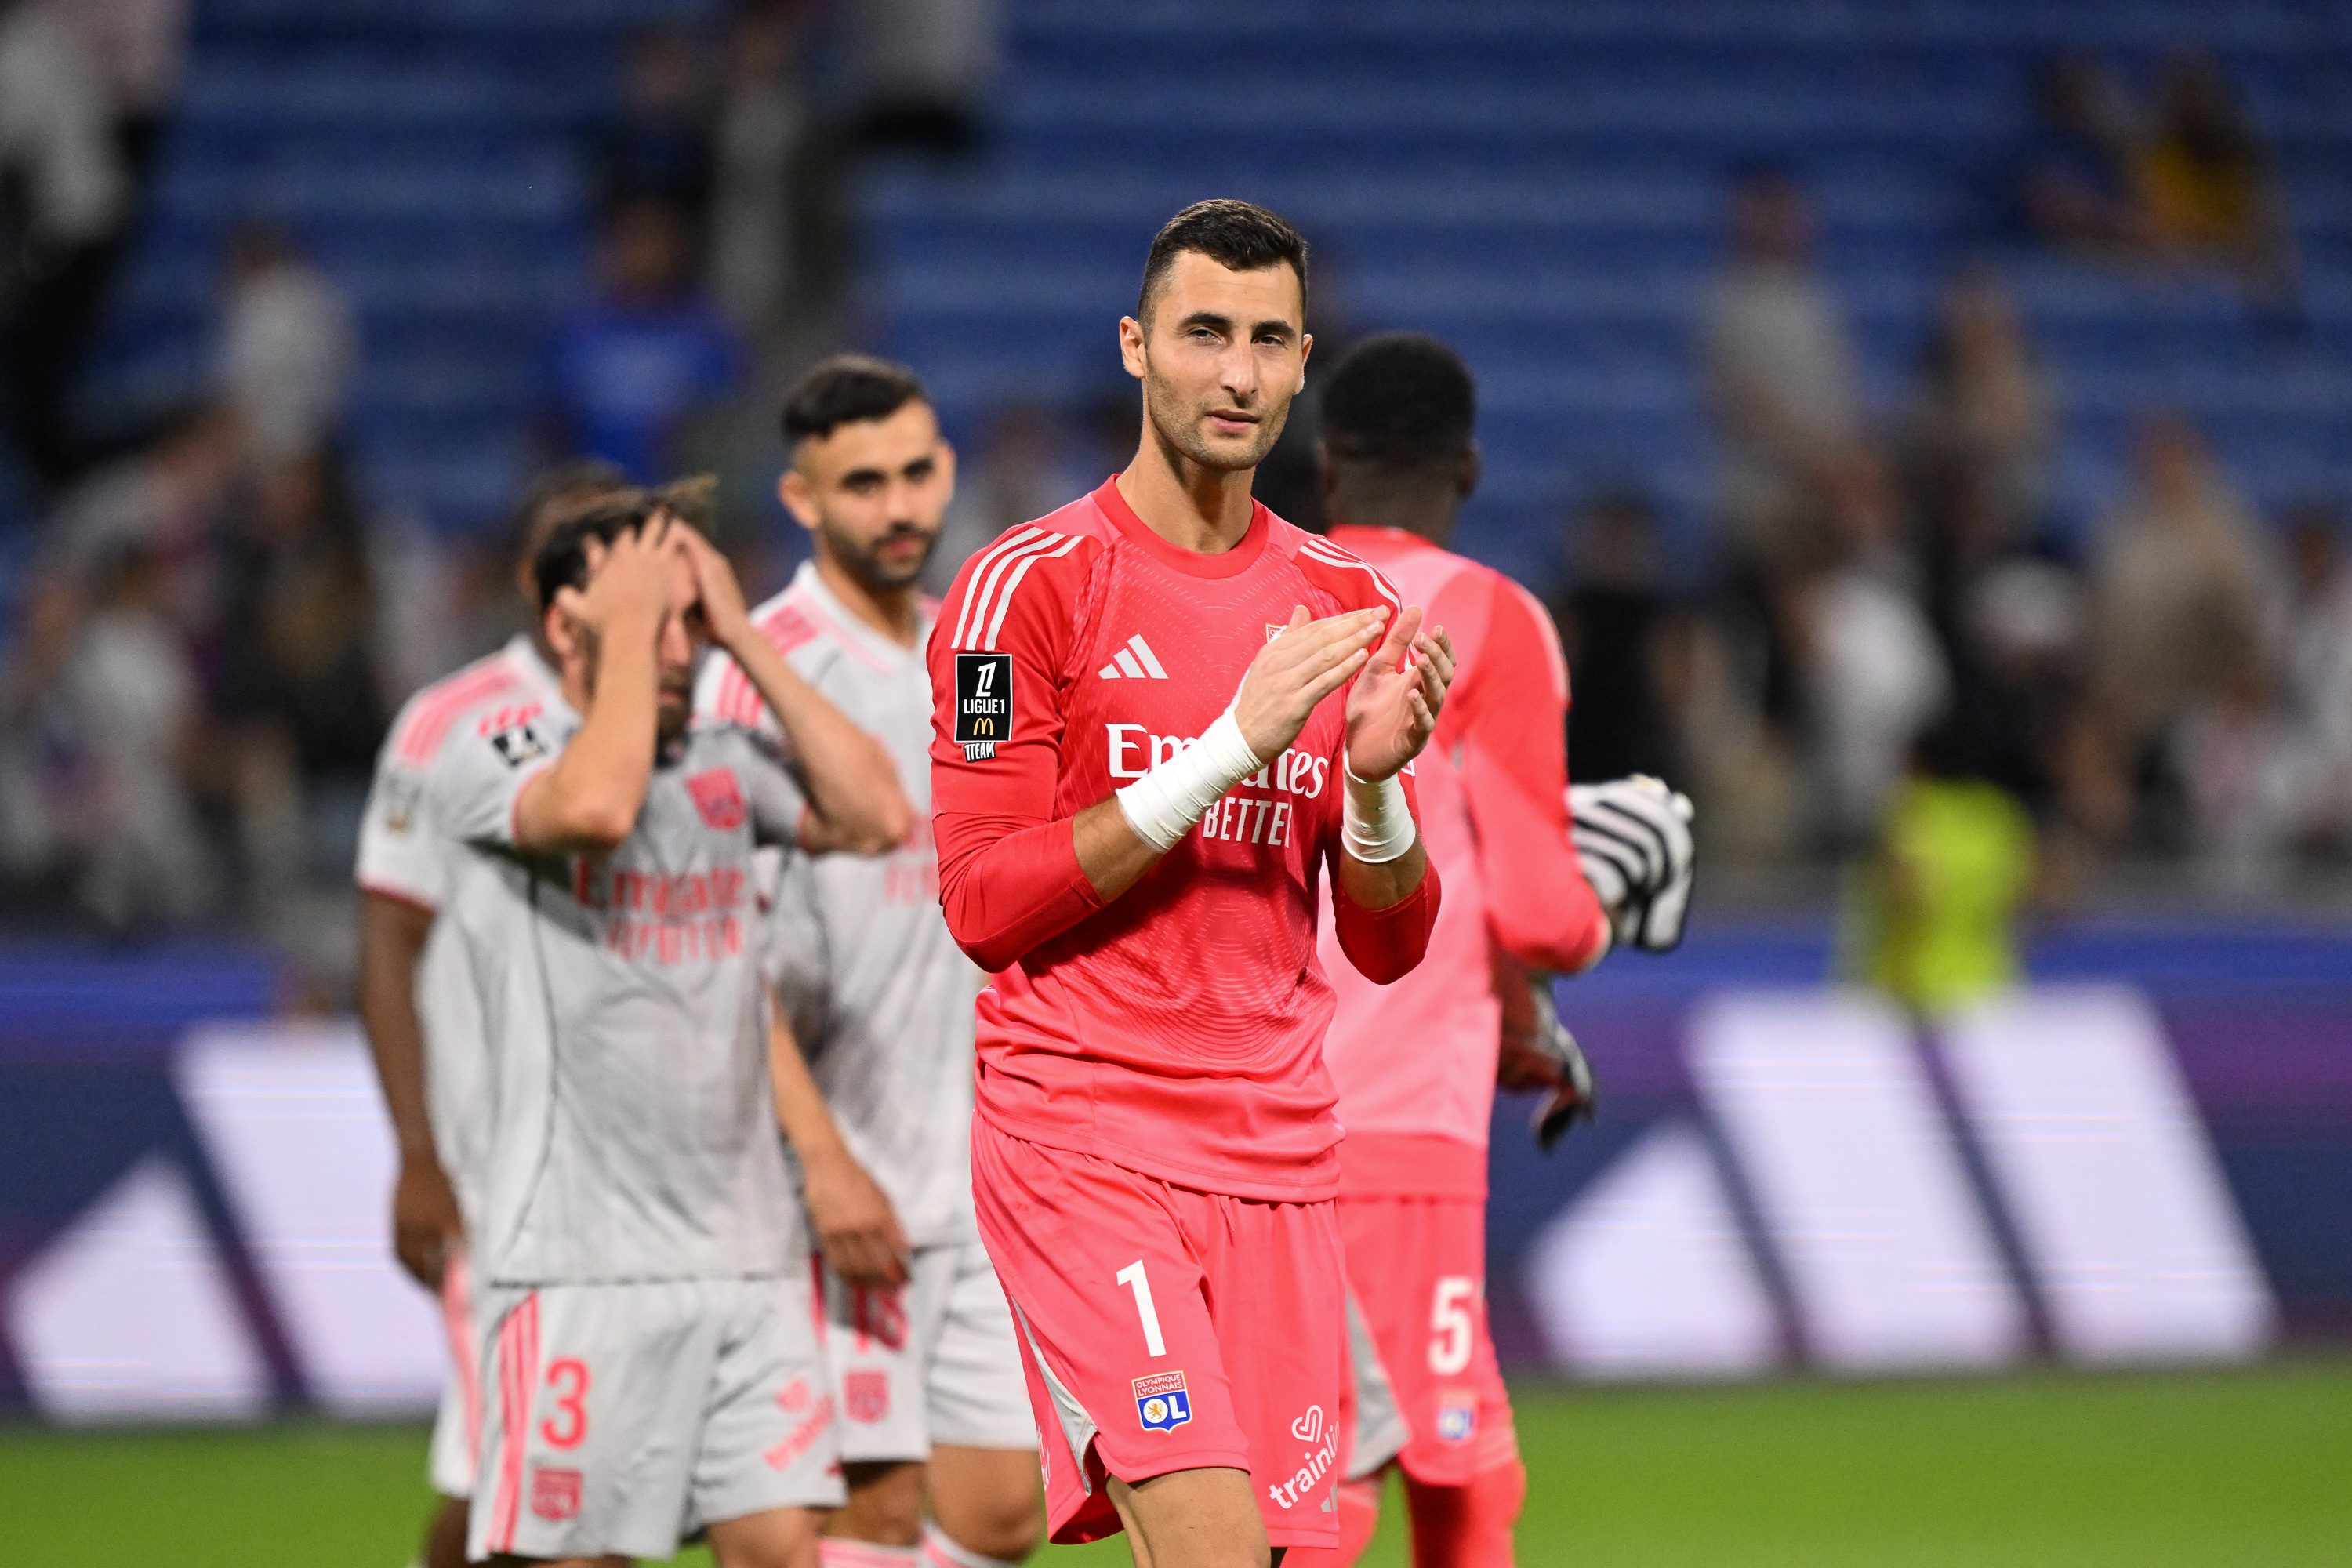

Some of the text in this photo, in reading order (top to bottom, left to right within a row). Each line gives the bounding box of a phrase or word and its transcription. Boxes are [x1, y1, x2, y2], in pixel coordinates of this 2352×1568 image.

[964, 699, 1005, 714] LIGUE 1
[964, 742, 996, 762] 1TEAM
[1105, 723, 1329, 799] Emtes
[1116, 1259, 1167, 1358] 1
[1428, 1276, 1472, 1376] 5
[539, 1356, 592, 1450] 3
[1136, 1374, 1181, 1388] OLYMPIQUE
[1137, 1381, 1183, 1396] LYONNAIS
